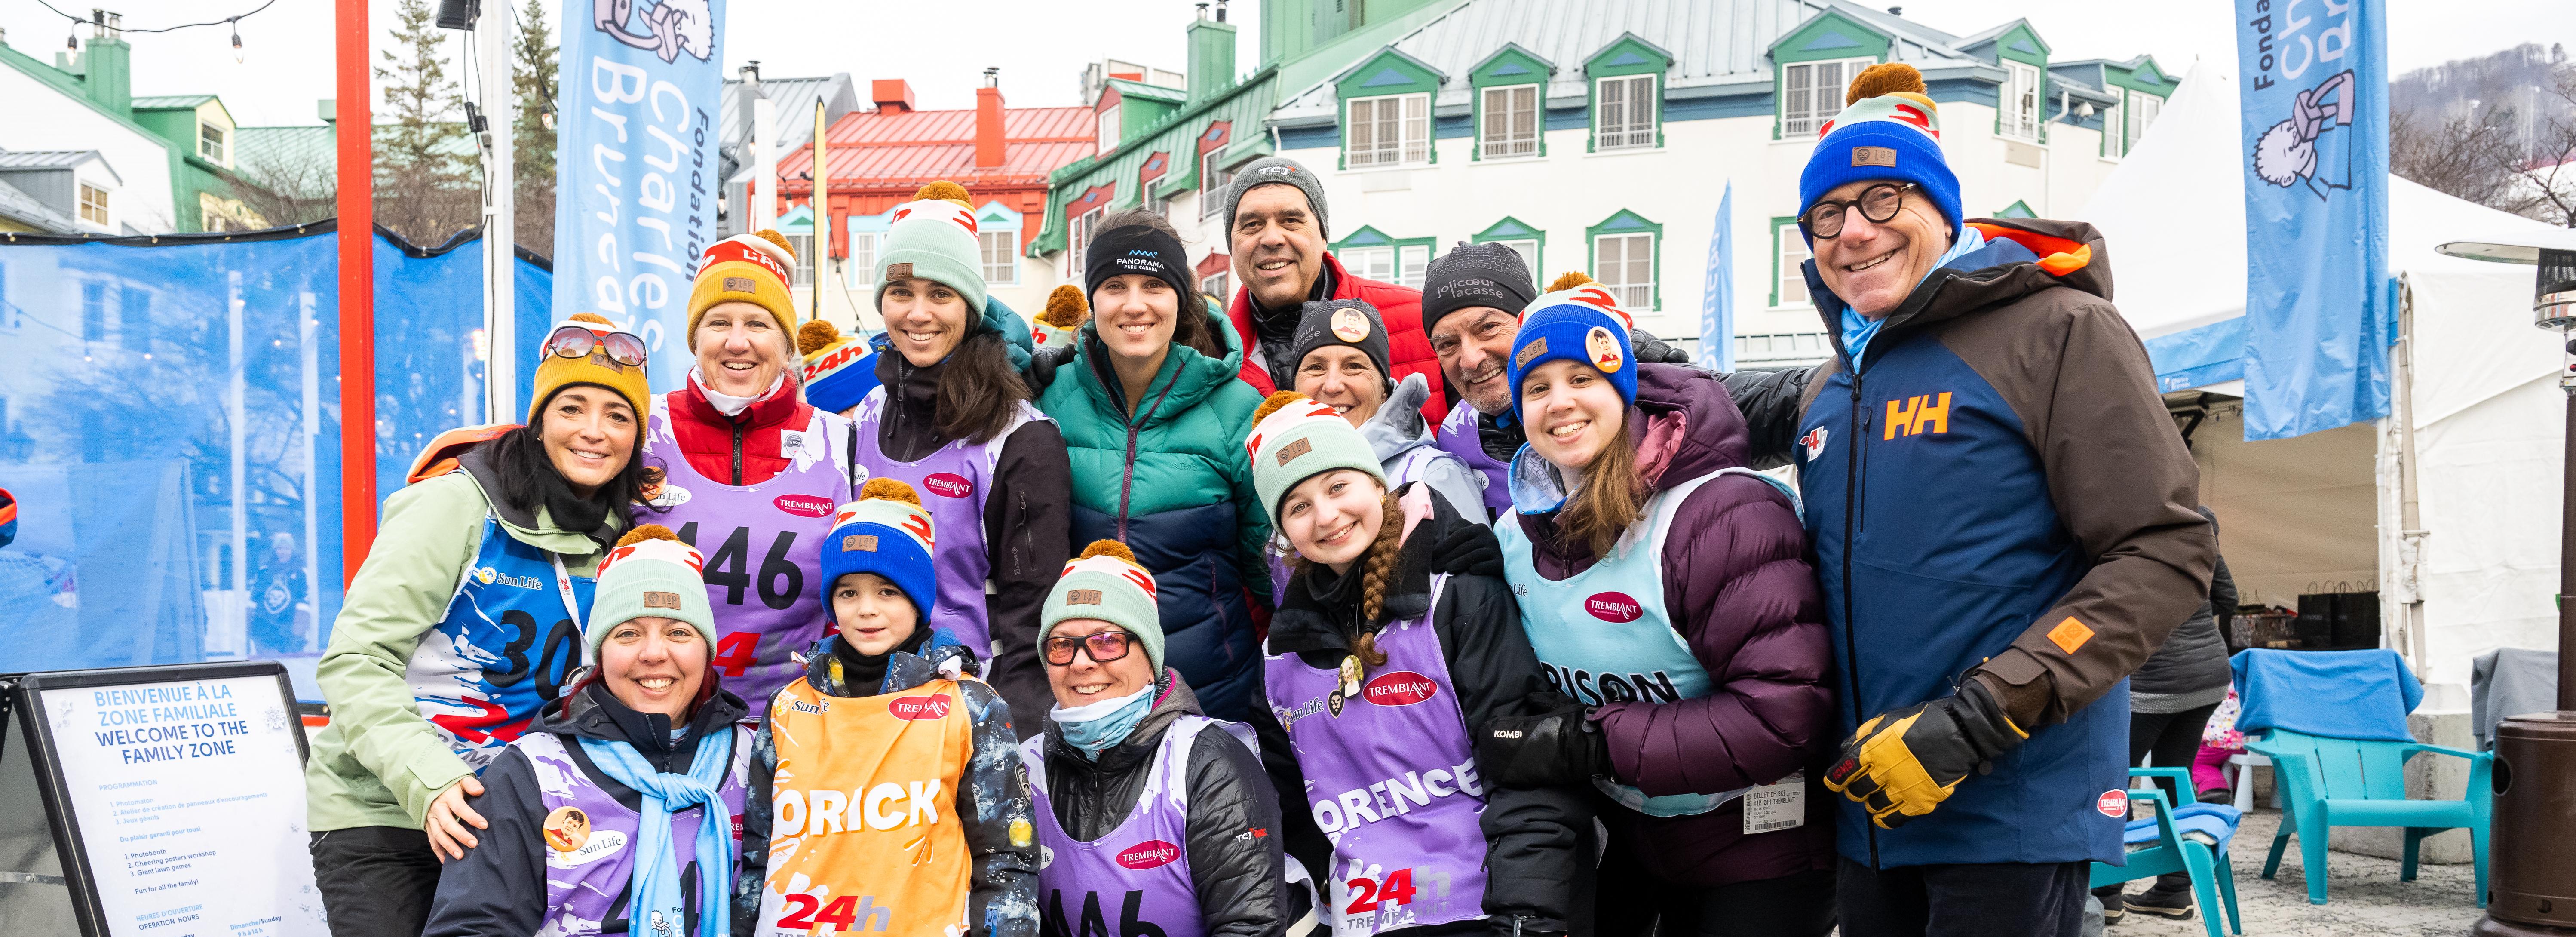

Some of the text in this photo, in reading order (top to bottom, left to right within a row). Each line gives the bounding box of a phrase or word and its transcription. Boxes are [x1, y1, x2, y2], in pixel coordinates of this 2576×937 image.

[592, 56, 647, 333] Brunea
[685, 106, 708, 282] Fondation
[629, 79, 691, 353] Charles
[1116, 258, 1164, 270] PANORAMA
[1478, 297, 1504, 306] AVOCATS
[804, 346, 863, 382] 24h
[1884, 392, 1952, 441] HH
[1179, 462, 1197, 471] Rab
[929, 478, 971, 496] TREMBLANT
[668, 491, 686, 502] Life
[780, 499, 833, 515] TREMBLANT
[499, 573, 543, 590] Sun Life
[1514, 583, 1528, 597] Life
[1591, 600, 1637, 620] TREMBLANT
[94, 682, 233, 707] BIENVENUE À LA
[1369, 681, 1431, 698] TREMBLANT
[98, 703, 237, 726] ZONE FAMILIALE
[792, 700, 819, 715] Sun
[1303, 697, 1324, 716] Life
[95, 720, 249, 747] WELCOME TO THE
[1494, 729, 1522, 739] KOMBI
[122, 740, 236, 764] FAMILY ZONE
[99, 779, 158, 791] PROGRAMMATION
[116, 798, 154, 808] Photomaton
[151, 803, 177, 812] création
[187, 799, 215, 809] panneaux
[216, 792, 268, 805] d'encouragements
[2101, 798, 2126, 812] TREMBLANT
[139, 814, 160, 824] géants
[130, 833, 148, 842] plaisir
[149, 830, 171, 840] garanti
[172, 828, 185, 836] pour
[131, 848, 166, 859] Photobooth
[579, 836, 622, 856] Sun Life
[135, 857, 164, 868] Cheering
[165, 854, 187, 864] posters
[187, 849, 216, 859] workshop
[1123, 848, 1175, 862] TREMBLANT
[137, 868, 154, 876] Giant
[172, 863, 191, 872] games
[178, 879, 199, 888] family!
[1346, 865, 1451, 915] 24h
[136, 904, 203, 922] HEURES D'OUVERTURE
[776, 894, 891, 932] 24h
[1347, 900, 1450, 930] TREMBLANT
[138, 914, 199, 931] OPERATION HOURS
[230, 915, 282, 931] Dimanche/Sunday
